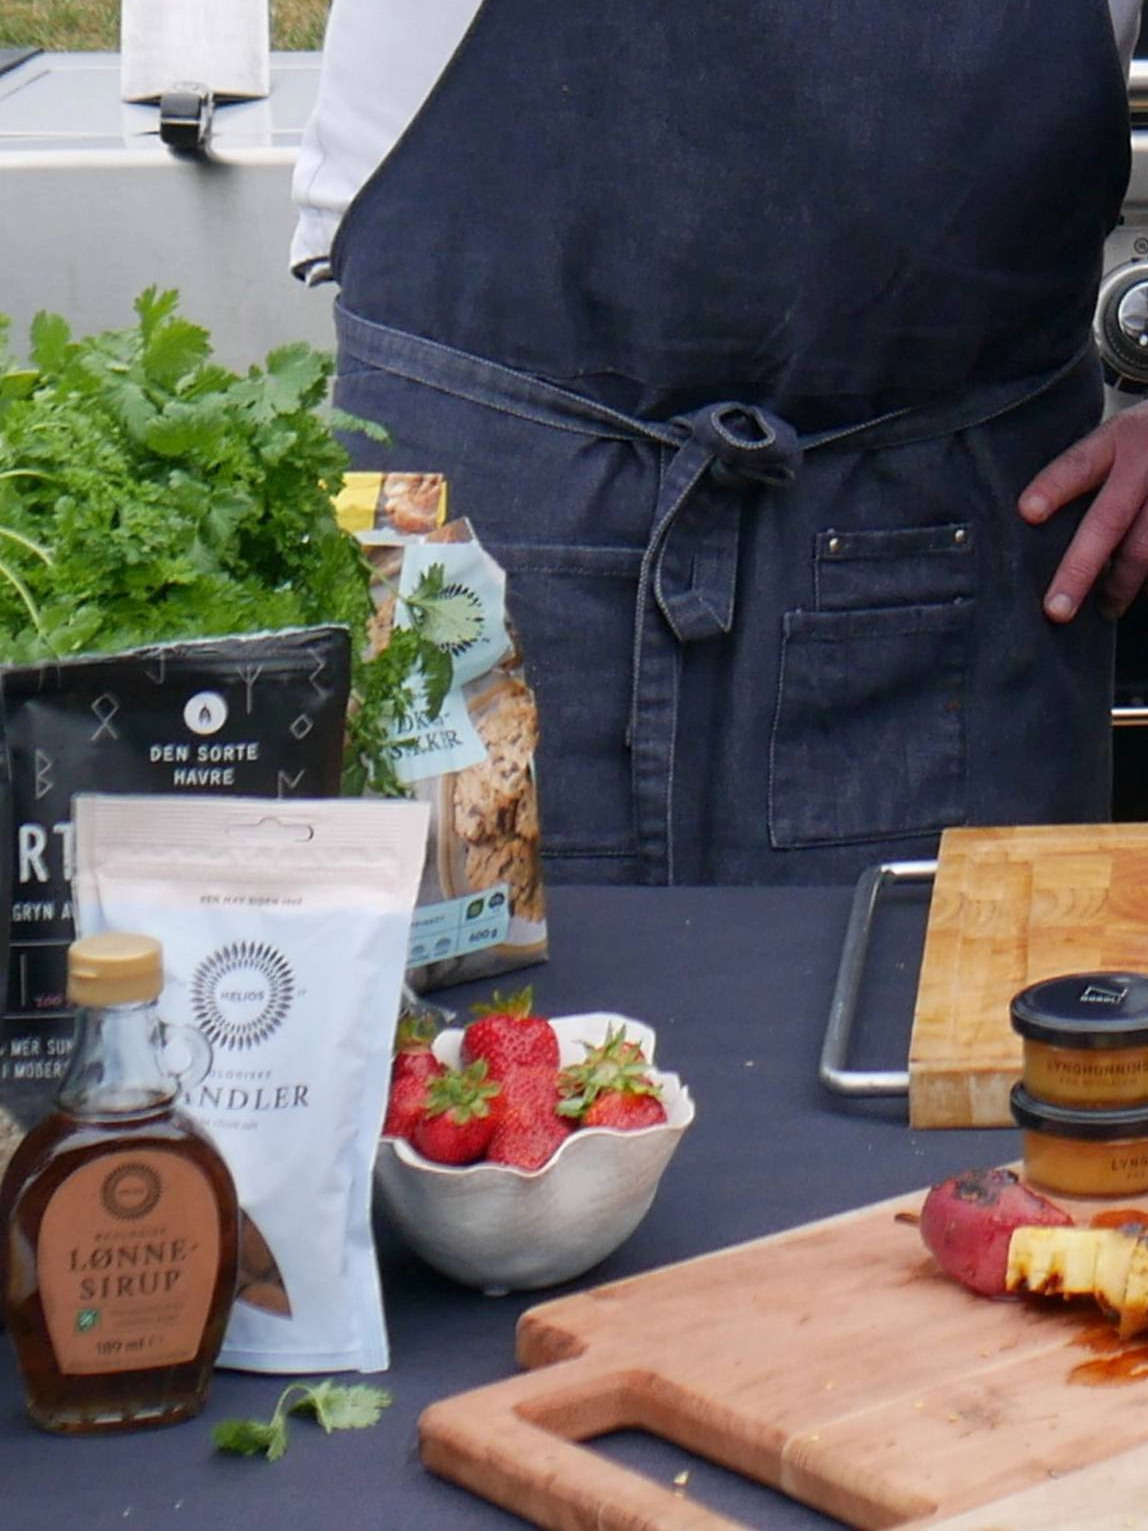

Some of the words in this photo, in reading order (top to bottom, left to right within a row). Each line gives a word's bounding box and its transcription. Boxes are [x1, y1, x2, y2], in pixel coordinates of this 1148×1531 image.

[150, 744, 189, 763] DEN
[197, 741, 261, 762] SORTE
[173, 767, 236, 786] HAVRE
[12, 901, 54, 922] GRYN
[220, 990, 265, 1003] HELIOS
[11, 1038, 39, 1057] MER
[68, 1238, 198, 1273] LØNNE-
[80, 1269, 180, 1301] SIRUP
